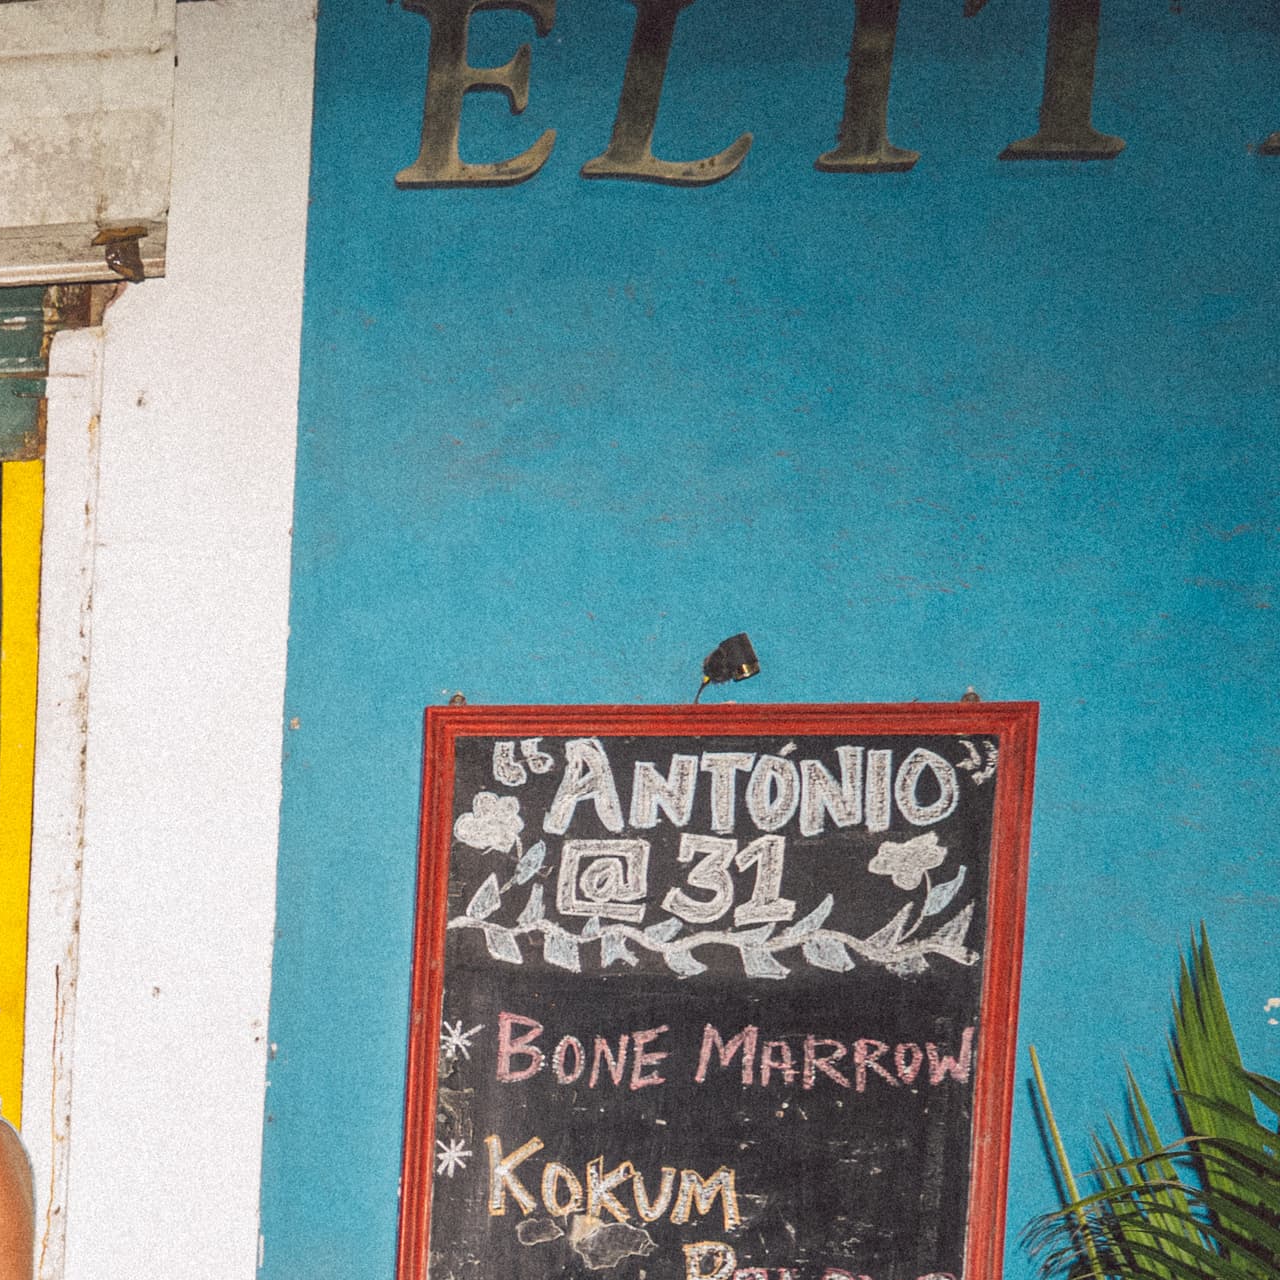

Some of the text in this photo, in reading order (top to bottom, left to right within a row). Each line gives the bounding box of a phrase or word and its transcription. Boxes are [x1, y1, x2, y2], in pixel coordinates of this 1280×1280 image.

[387, 0, 1280, 190] ELIT
[662, 833, 797, 926] 31
[496, 1011, 977, 1093] BONE MARROW
[484, 1135, 740, 1231] KOKUM
